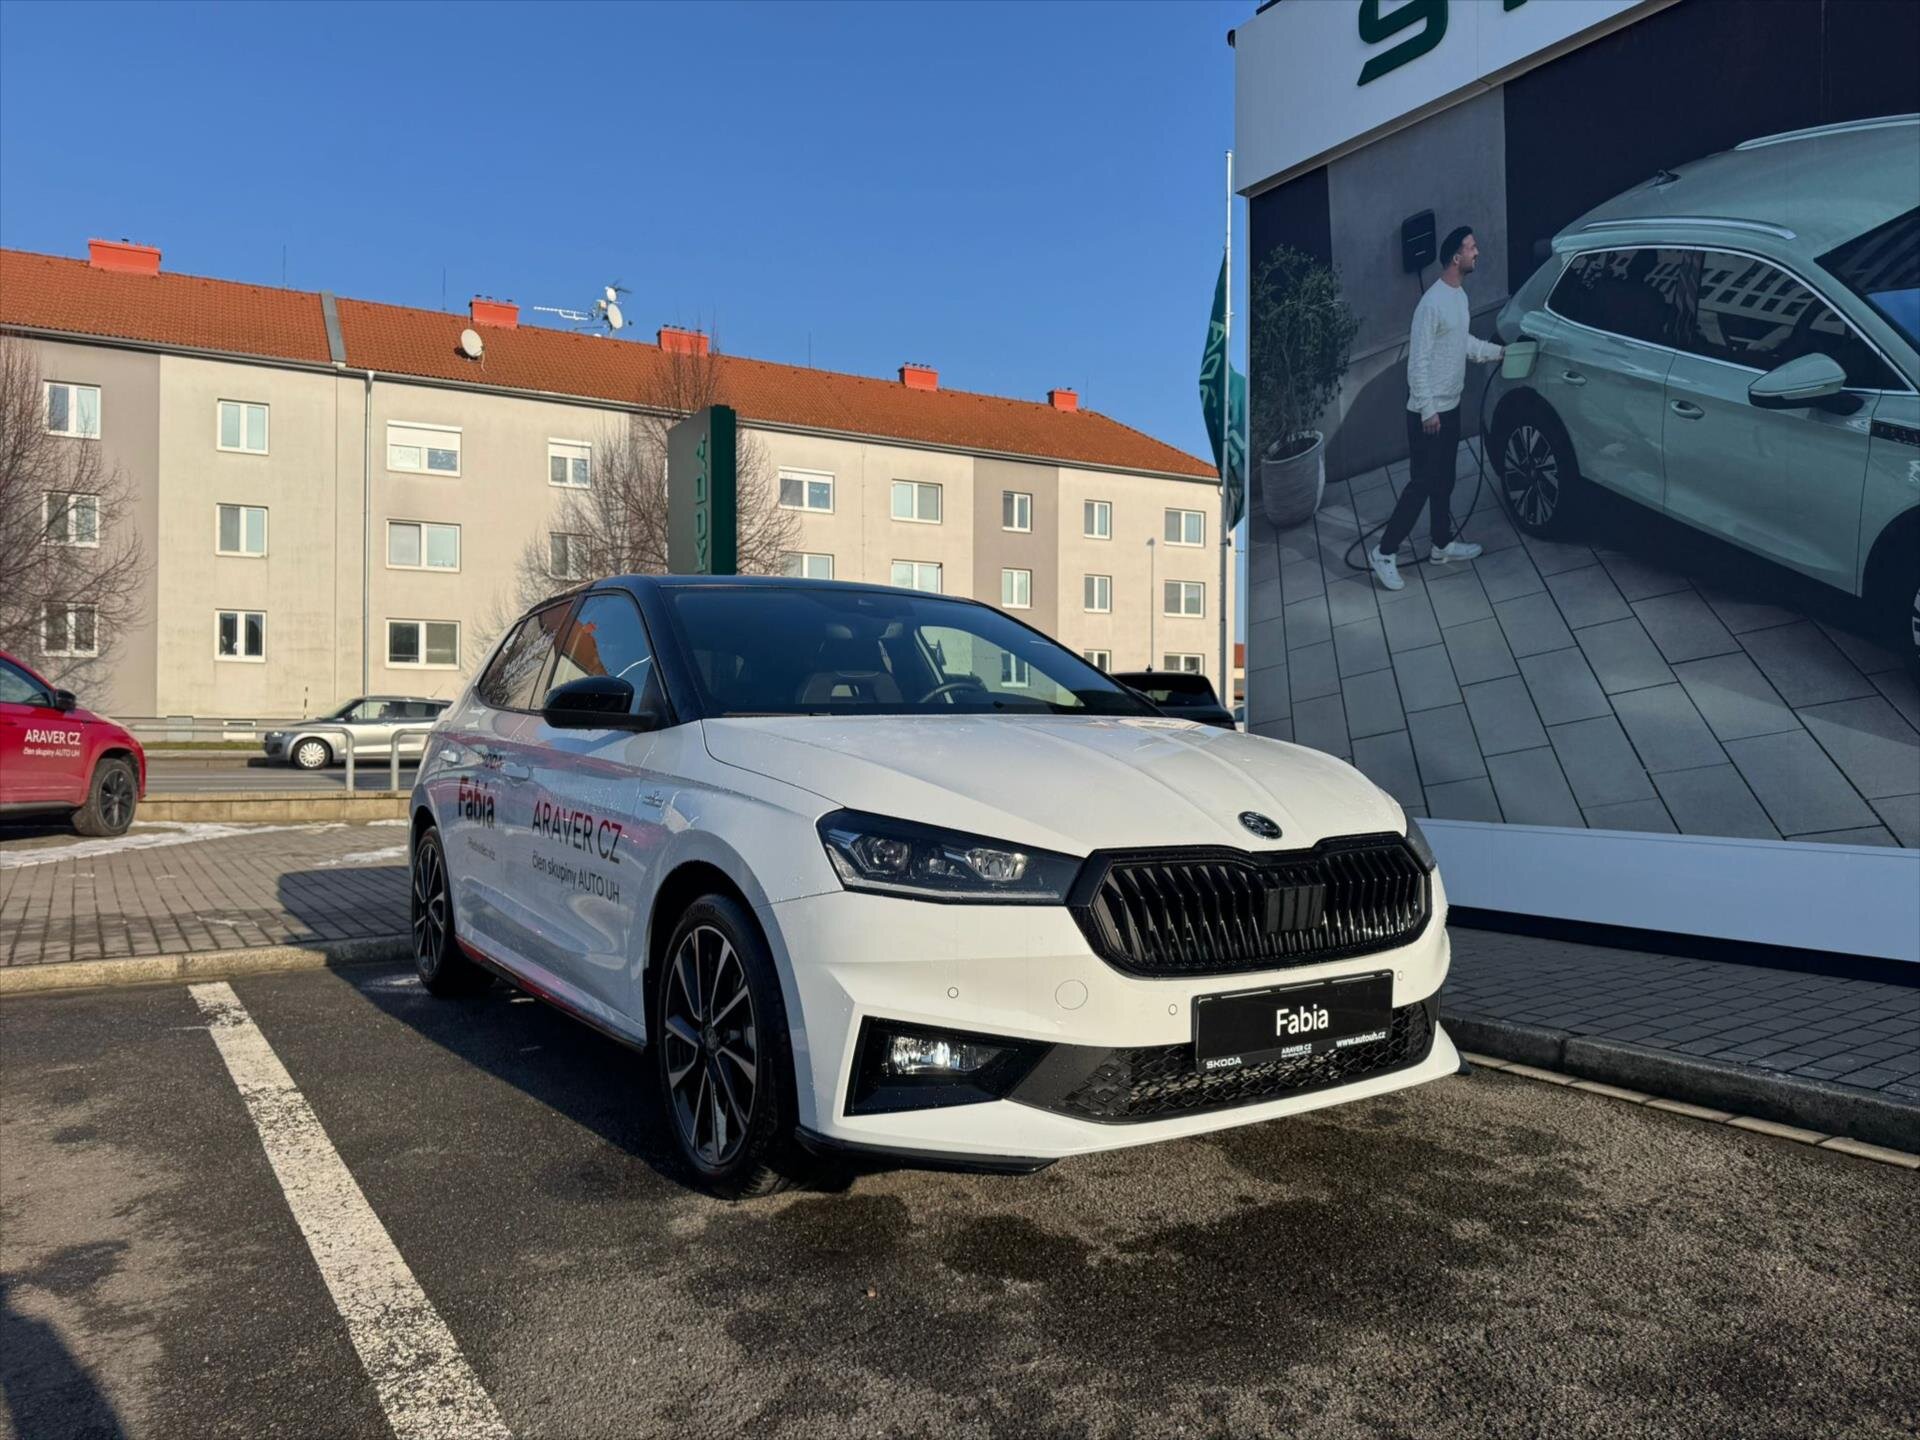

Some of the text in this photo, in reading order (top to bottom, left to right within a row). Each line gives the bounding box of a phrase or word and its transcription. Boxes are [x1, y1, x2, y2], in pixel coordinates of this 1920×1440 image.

[24, 729, 81, 745] ARAVER CZ
[55, 749, 71, 757] AUTO
[458, 775, 495, 830] Fabia
[531, 800, 594, 854] ARAVER
[598, 819, 623, 864] CZ
[532, 849, 620, 904] člen skupiny AUTO UH
[1276, 1004, 1329, 1036] Fabia
[1281, 1045, 1304, 1054] ARAVER
[1304, 1043, 1312, 1051] CZ
[1336, 1031, 1387, 1048] www.autouh.cz
